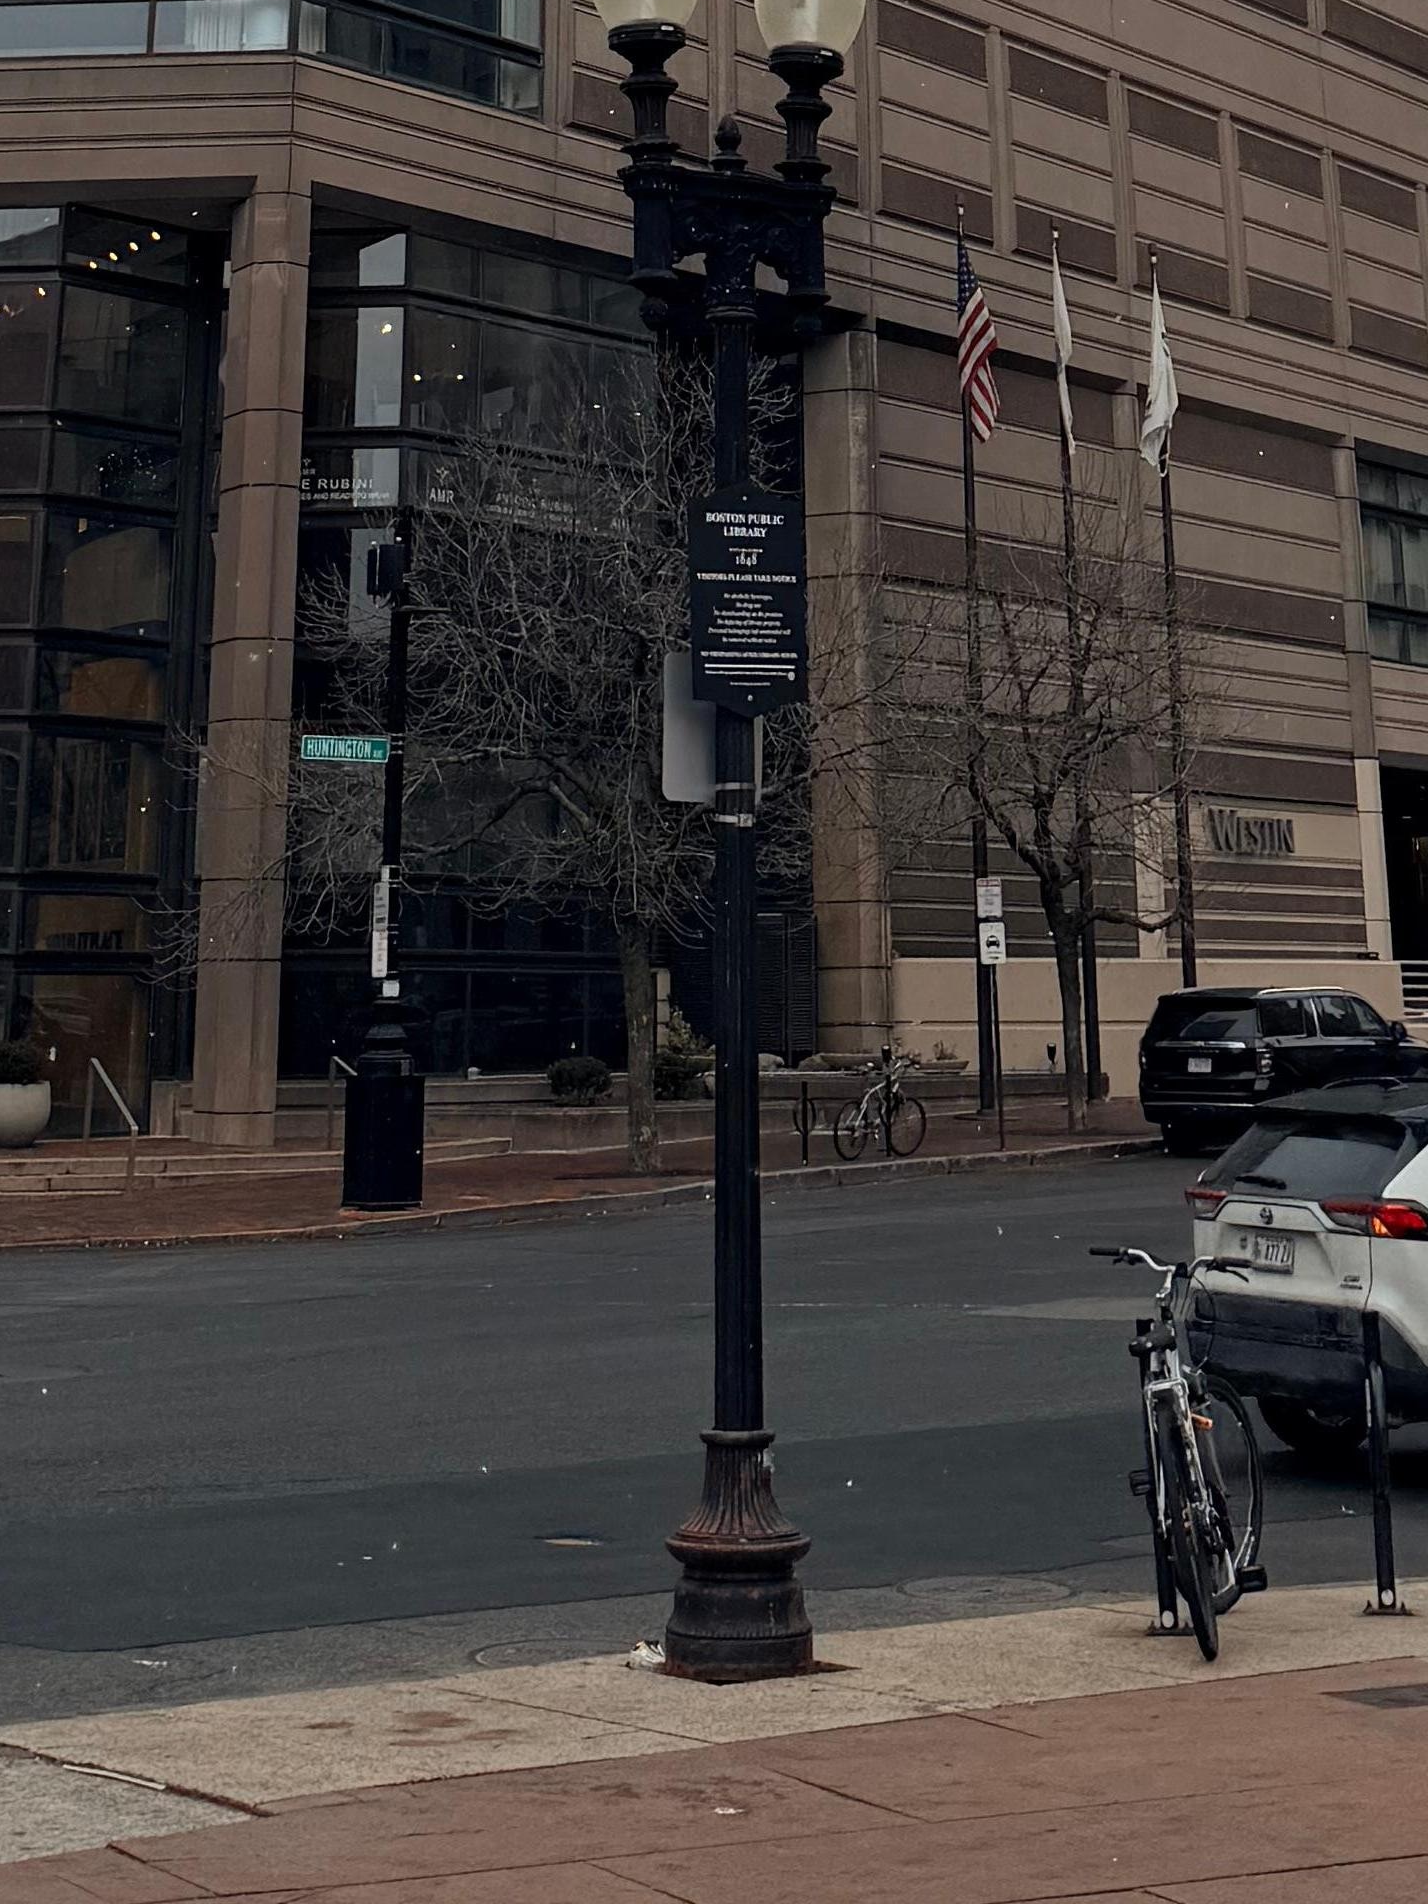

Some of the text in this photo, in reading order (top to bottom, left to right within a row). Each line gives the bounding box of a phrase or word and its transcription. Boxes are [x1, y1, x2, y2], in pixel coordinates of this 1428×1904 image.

[318, 478, 373, 490] RUBINI
[705, 512, 785, 525] BOSTON PUBLIC
[723, 526, 768, 538] LIBRARY
[735, 552, 758, 567] 1848
[306, 739, 372, 758] HUNTINGTON
[1208, 808, 1295, 854] WESTIN
